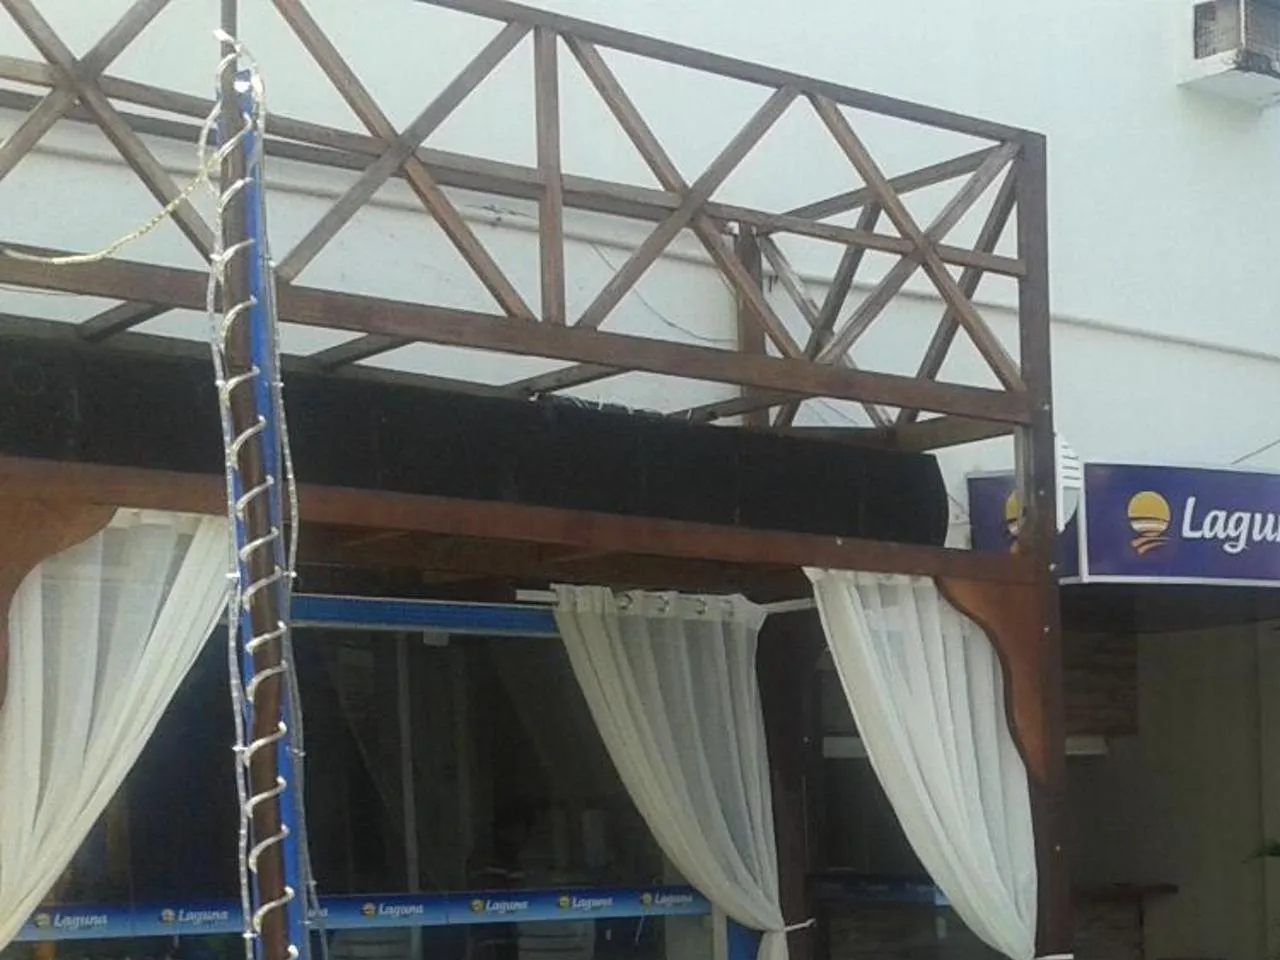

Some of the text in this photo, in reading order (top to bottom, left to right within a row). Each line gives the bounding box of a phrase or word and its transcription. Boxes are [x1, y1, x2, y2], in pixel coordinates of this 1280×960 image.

[379, 902, 424, 917] Laguna
[485, 900, 529, 912] Laguna
[572, 895, 613, 910] Laguna
[53, 911, 108, 928] Laguna
[178, 907, 229, 923] Laguna
